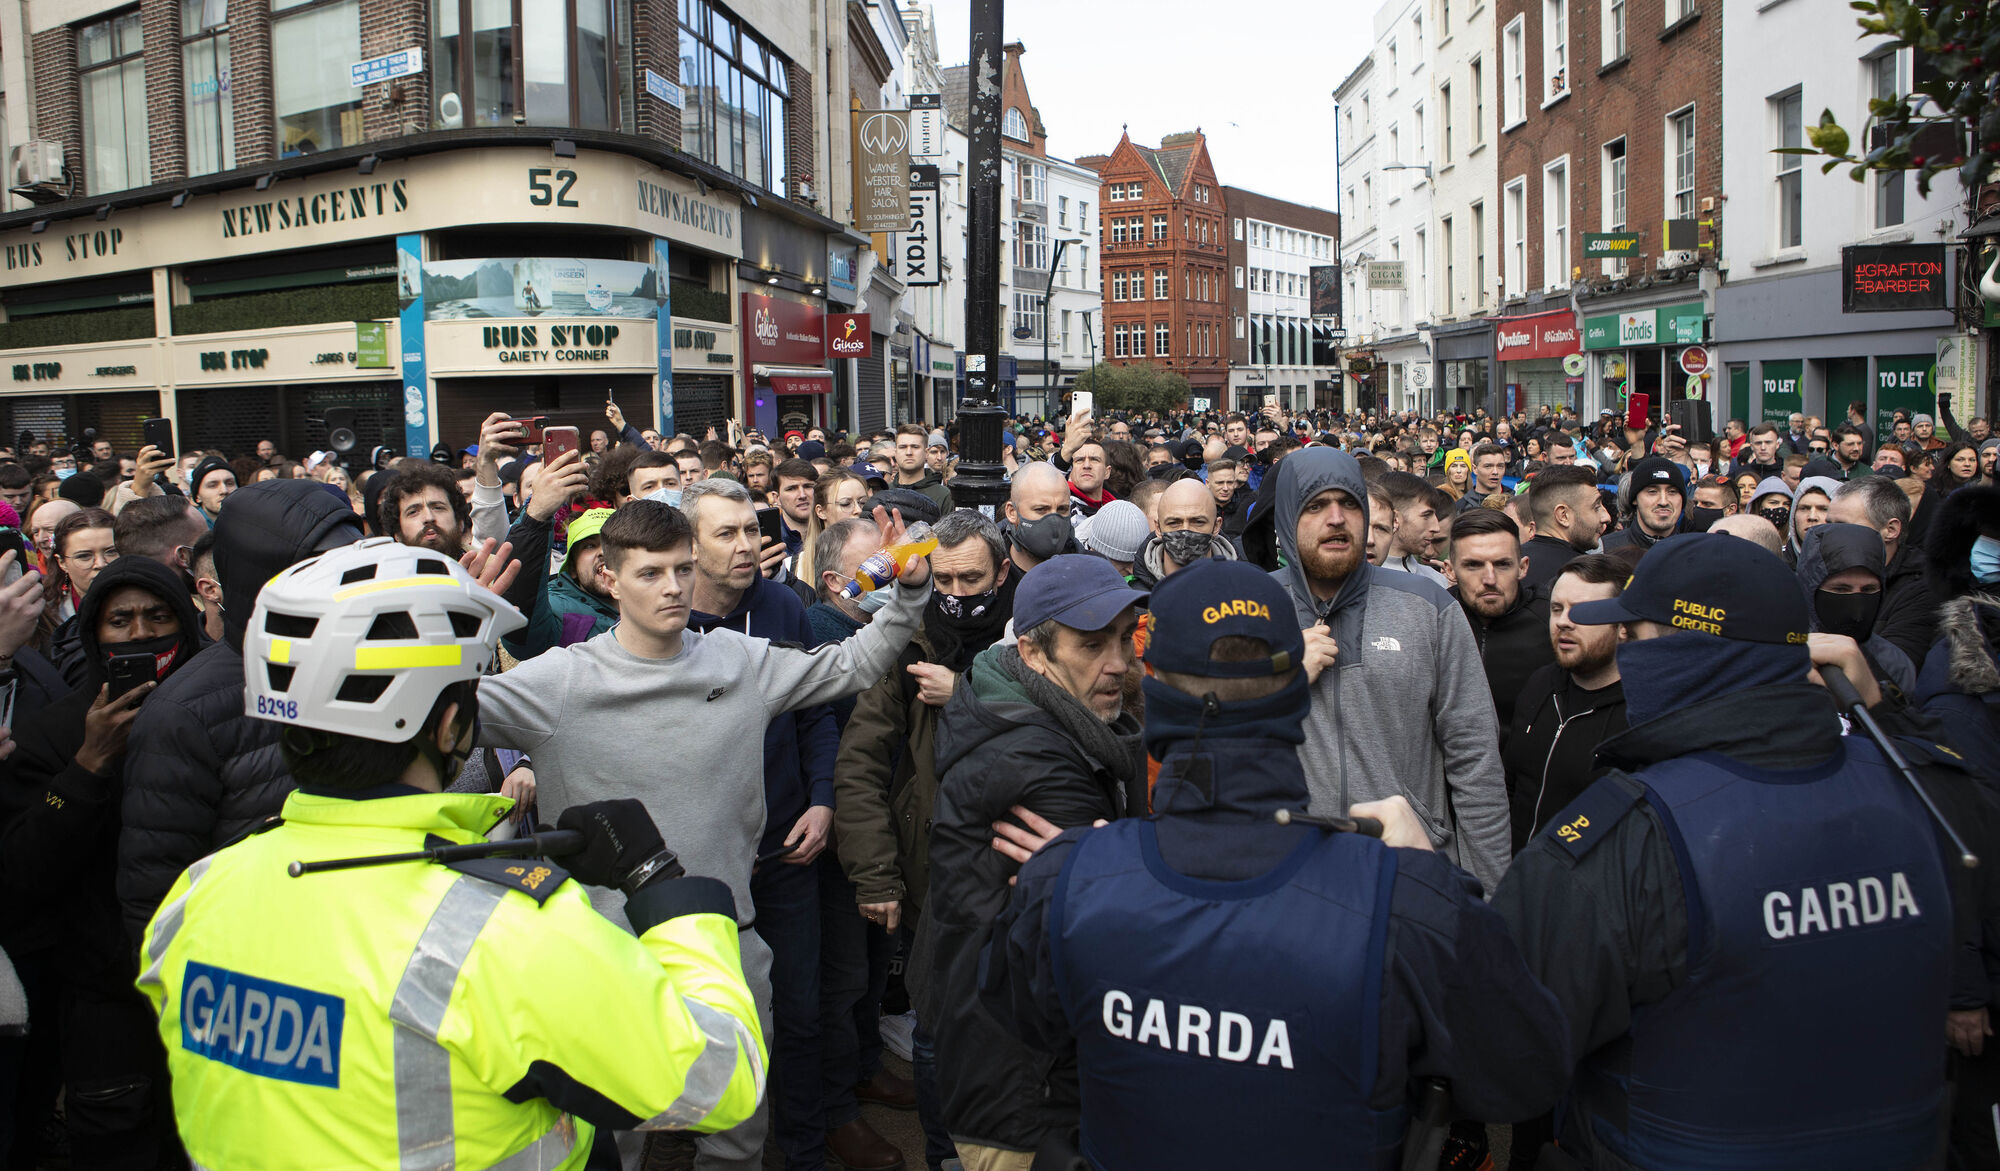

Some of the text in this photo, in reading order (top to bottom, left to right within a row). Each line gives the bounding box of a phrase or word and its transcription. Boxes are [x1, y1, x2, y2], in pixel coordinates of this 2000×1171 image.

[367, 68, 387, 79] STREET
[921, 111, 930, 153] FUJIFILM
[868, 164, 898, 173] WAYNE
[528, 168, 579, 207] 52
[865, 176, 906, 187] WEBSTER
[874, 188, 897, 198] HAIR
[223, 179, 408, 238] NEWSAGENTS
[637, 180, 733, 240] NEWSAGENTS
[872, 199, 899, 208] SALON
[907, 196, 928, 276] instax
[1588, 239, 1634, 251] SUBWAY
[6, 228, 123, 270] BUS STOP
[1370, 271, 1402, 279] CIGAR
[1864, 262, 1942, 277] GRAFTON
[1864, 279, 1931, 293] BARBER
[755, 309, 779, 340] Gino's
[1623, 321, 1652, 340] Londis
[483, 326, 619, 348] BUS STOP
[761, 338, 776, 346] GELATO
[832, 337, 864, 351] Gino's
[1505, 331, 1530, 346] vodafone
[200, 348, 268, 370] BUS STOP
[499, 350, 609, 362] GAIETY CORNER
[33, 362, 62, 381] STOP
[1880, 371, 1924, 387] TO LET
[1937, 366, 1955, 377] MHR
[1764, 380, 1795, 392] TO LET
[1202, 600, 1271, 624] GARDA
[1673, 599, 1726, 621] PUBLIC
[1671, 615, 1722, 635] ORDER
[711, 687, 724, 696] NIKE
[257, 695, 298, 719] B298
[1575, 815, 1590, 829] P
[1556, 824, 1581, 843] 97
[505, 866, 525, 876] B
[521, 866, 551, 890] 298
[1763, 872, 1920, 940] GARDA
[184, 974, 335, 1078] GARDA
[1103, 989, 1295, 1069] GARDA
